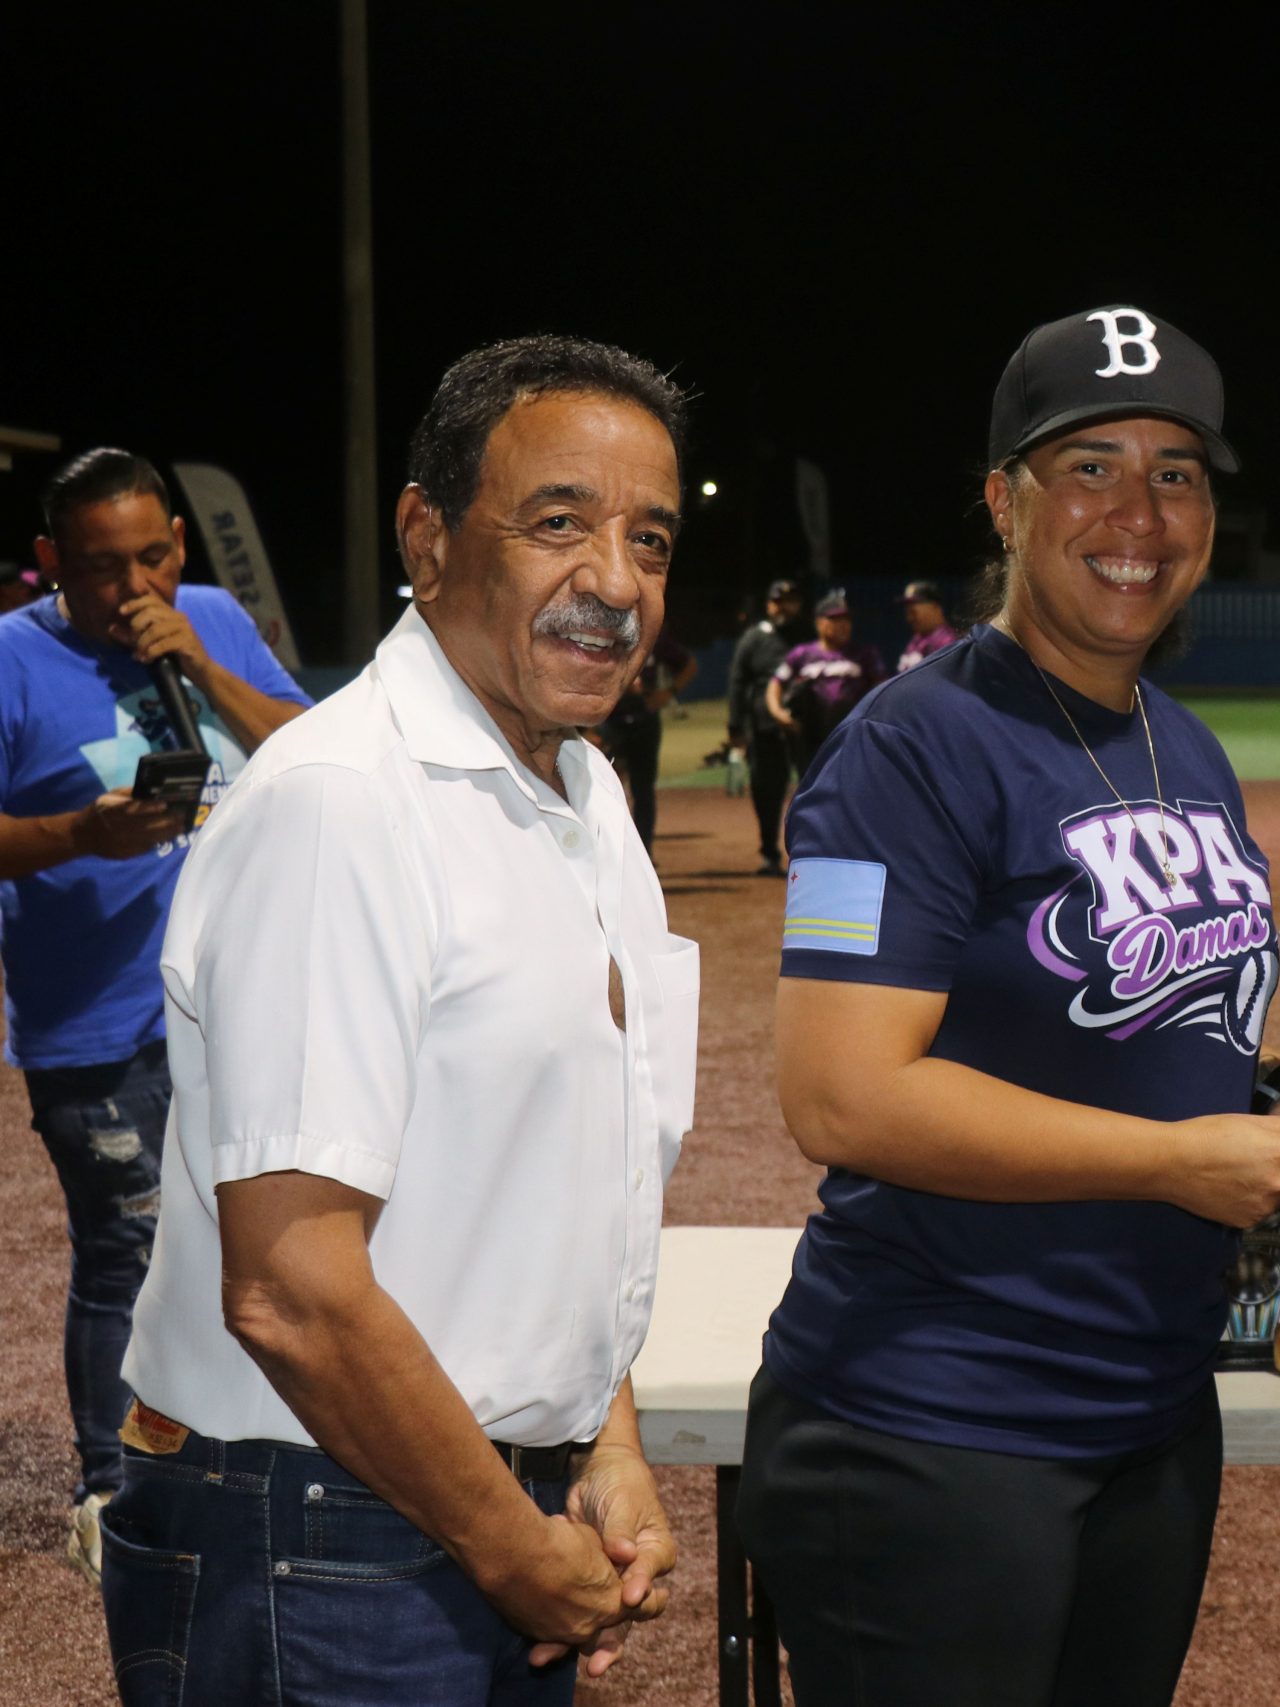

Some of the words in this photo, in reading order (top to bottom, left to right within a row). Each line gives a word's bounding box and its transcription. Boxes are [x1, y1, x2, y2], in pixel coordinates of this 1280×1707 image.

[1086, 308, 1161, 378] B
[1062, 806, 1271, 936] KPA
[1107, 903, 1270, 1000] Damas
